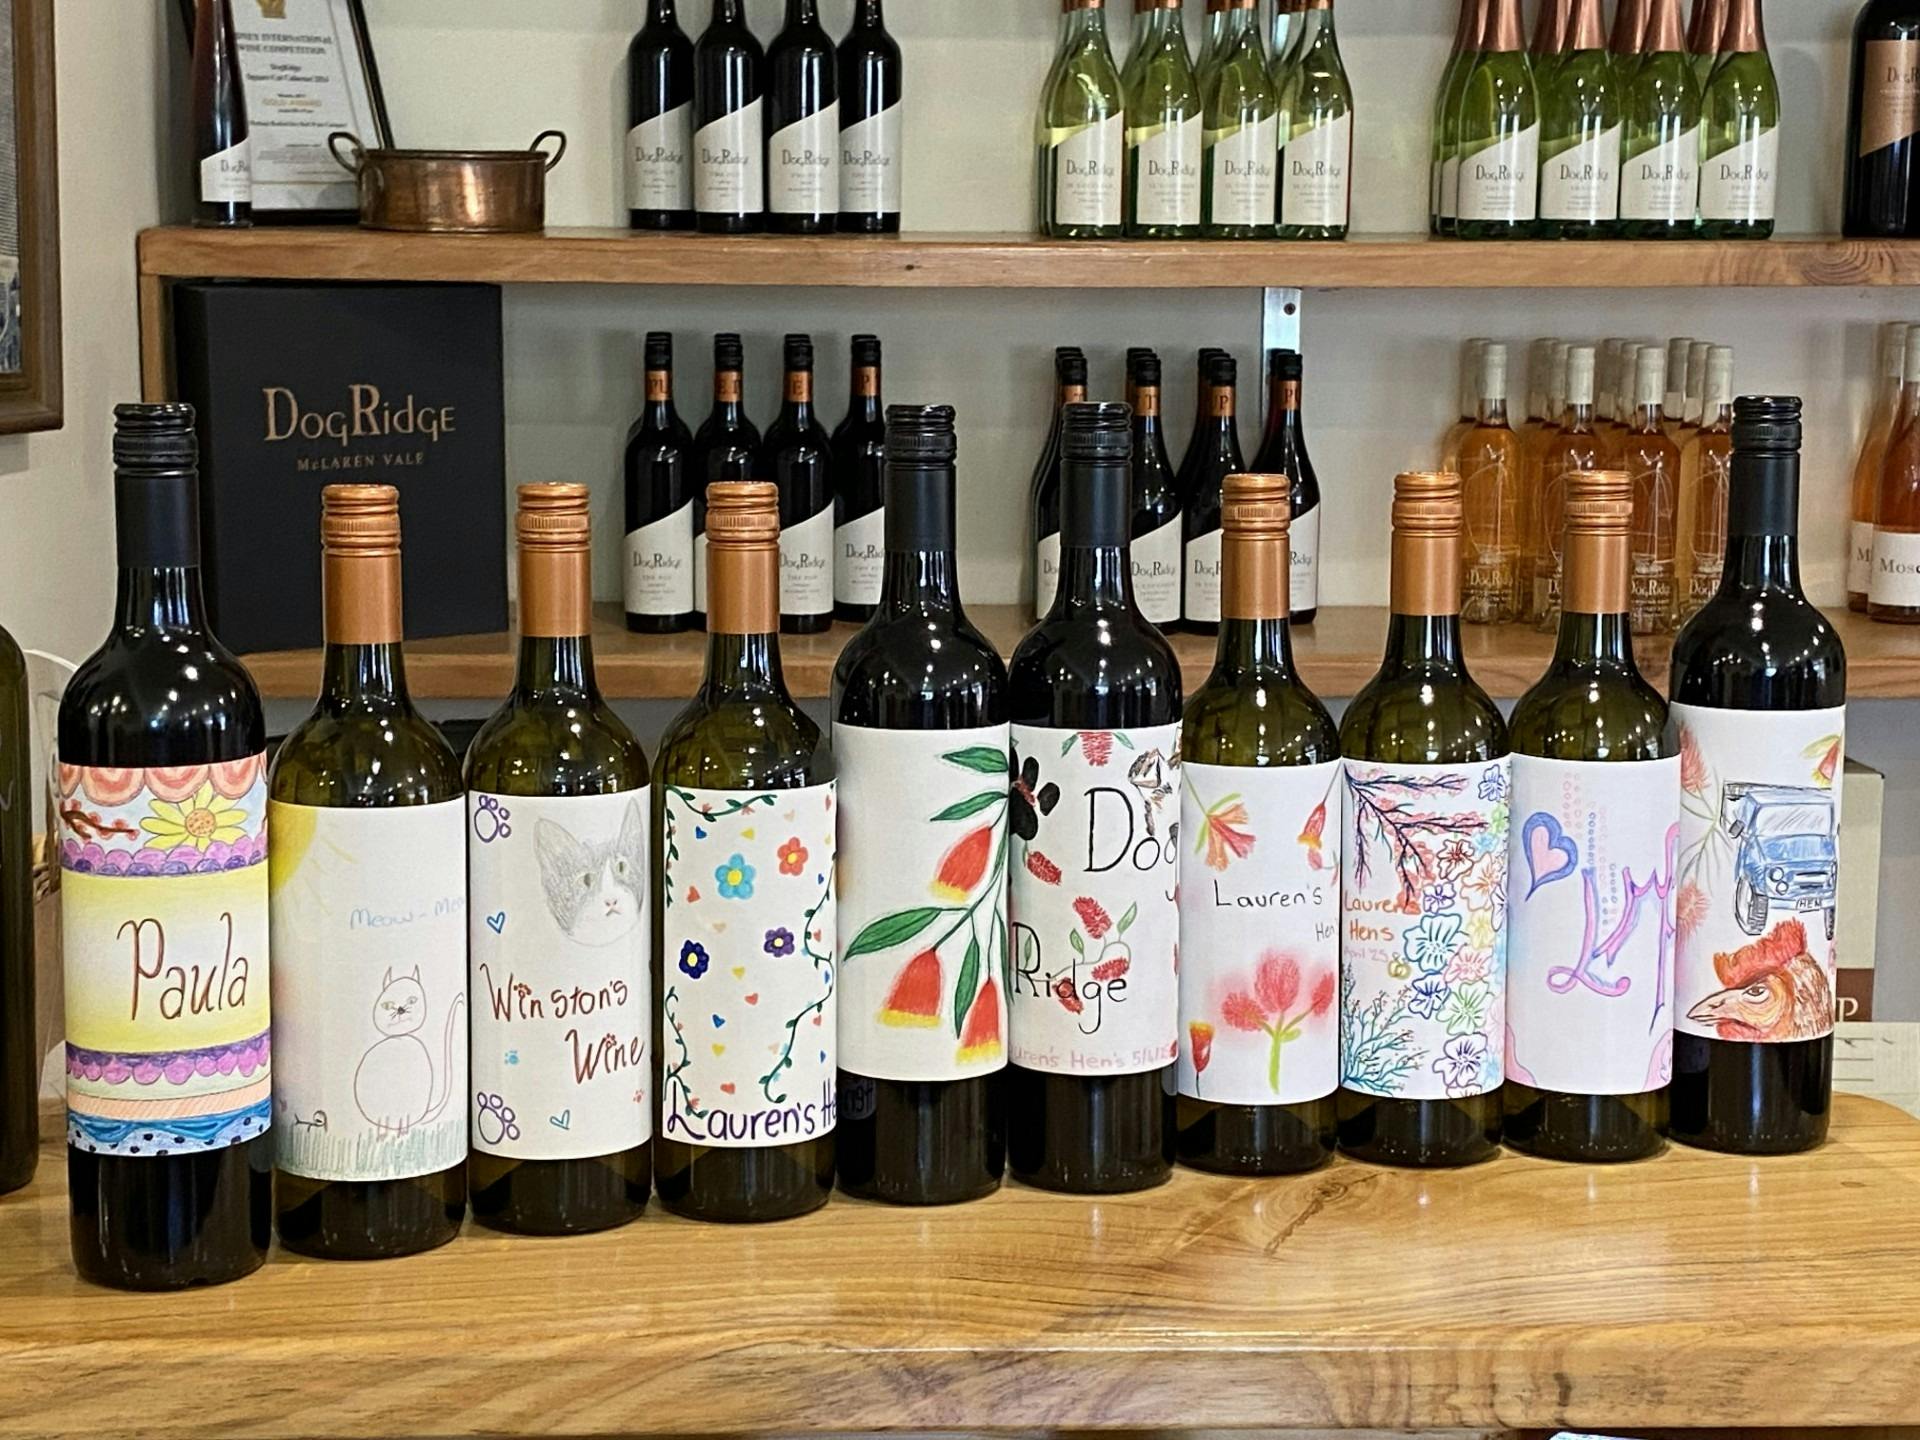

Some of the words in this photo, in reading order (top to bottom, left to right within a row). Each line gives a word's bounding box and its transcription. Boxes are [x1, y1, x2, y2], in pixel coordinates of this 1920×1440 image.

[262, 383, 456, 447] DogRidge
[383, 451, 425, 466] VALE
[1214, 879, 1323, 908] Lauren's
[116, 912, 249, 1021] Paula
[479, 963, 629, 1022] Winston's
[1012, 921, 1128, 1034] Ridge
[564, 1029, 645, 1085] Wine
[667, 1081, 816, 1141] Lauren's
